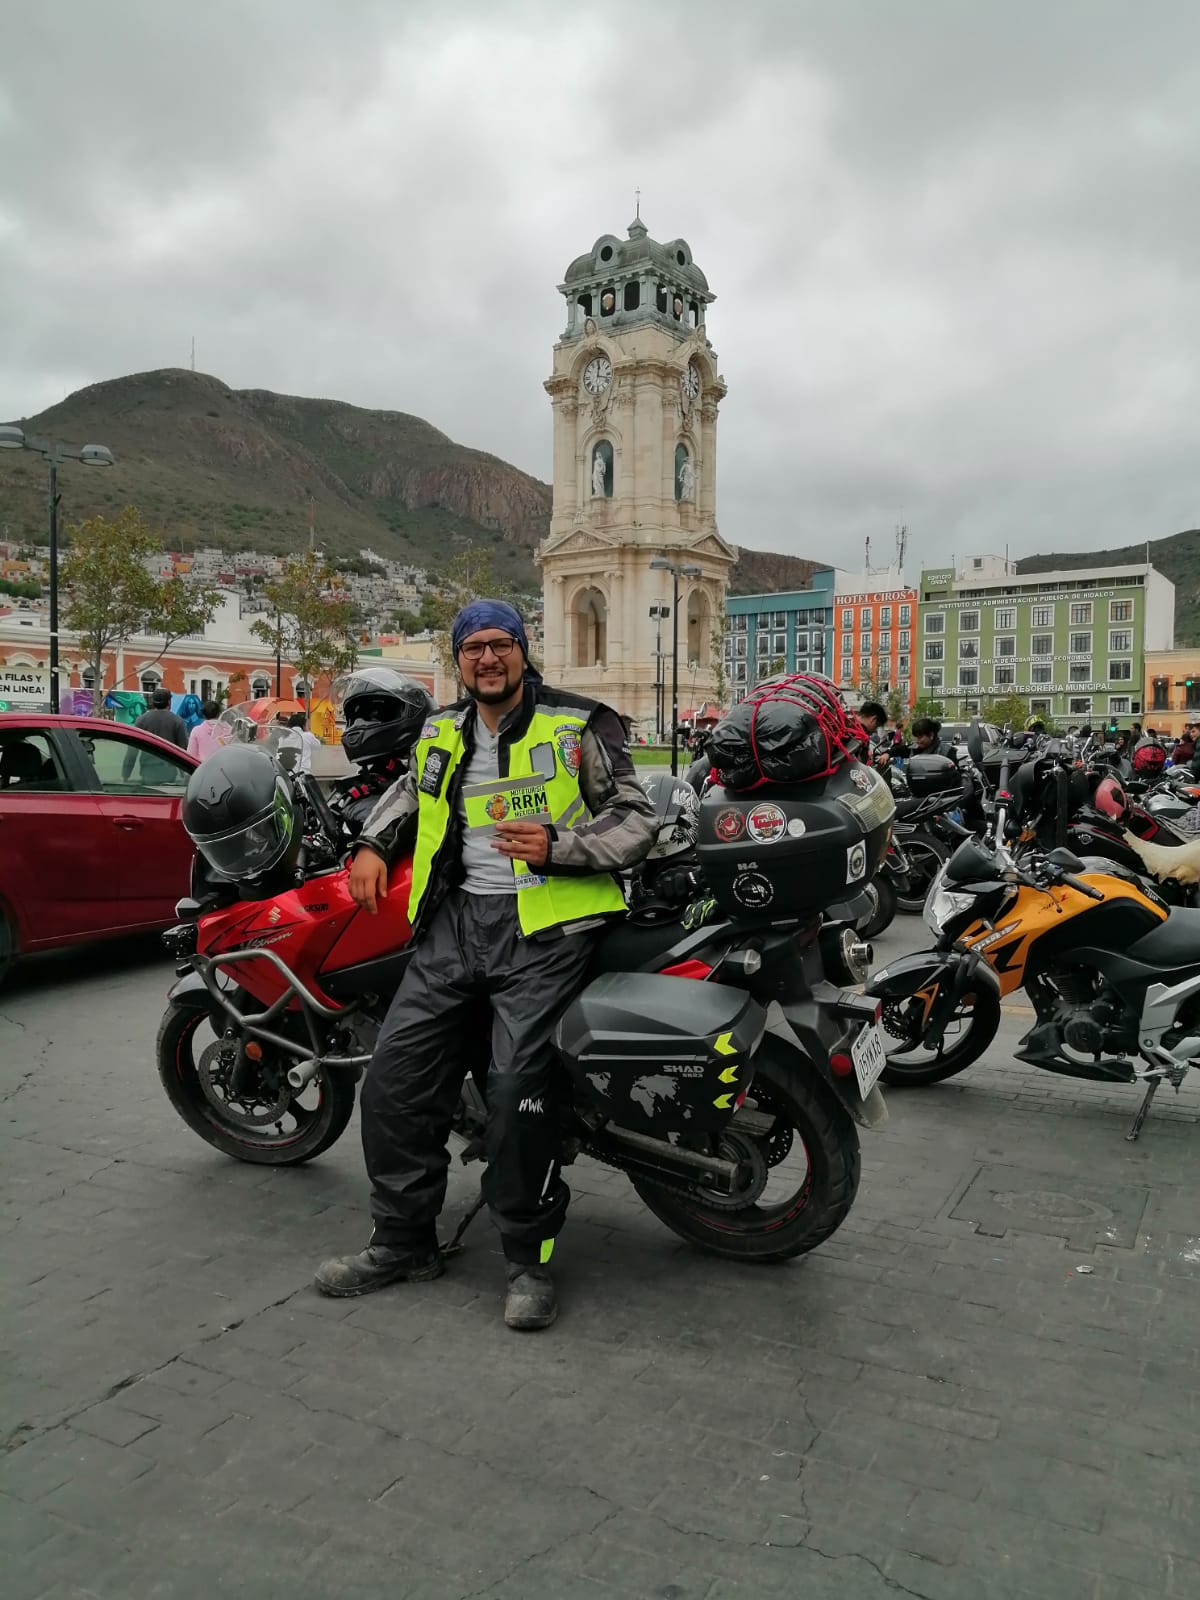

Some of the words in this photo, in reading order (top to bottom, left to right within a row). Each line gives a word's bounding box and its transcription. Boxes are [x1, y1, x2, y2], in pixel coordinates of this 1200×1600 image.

[836, 594, 869, 605] HOTEL
[873, 591, 906, 602] CIROS
[5, 674, 33, 682] FILAS
[1015, 684, 1064, 693] TESORERIA
[1066, 683, 1113, 691] MUNICIPAL
[511, 791, 548, 811] RRM
[662, 1065, 705, 1073] SHAD
